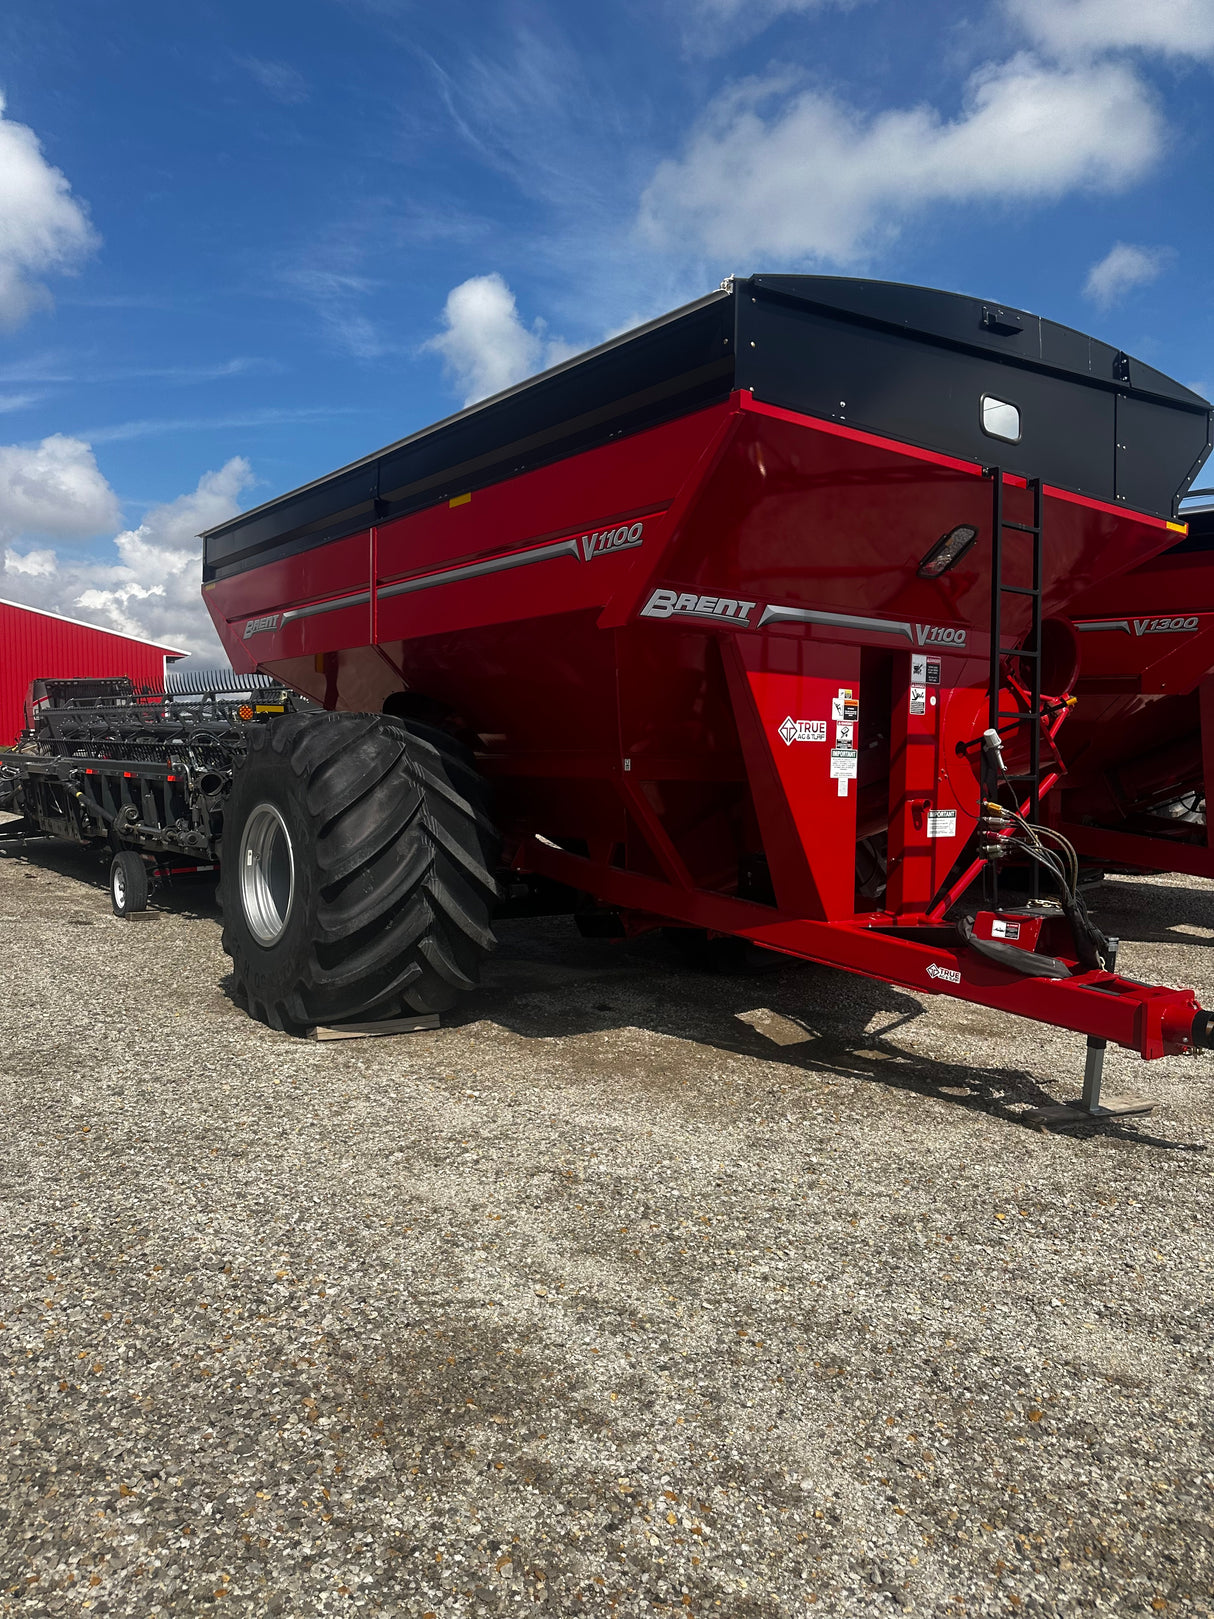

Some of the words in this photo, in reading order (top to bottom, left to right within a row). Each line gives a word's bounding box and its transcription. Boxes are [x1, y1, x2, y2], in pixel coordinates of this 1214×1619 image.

[582, 523, 643, 561] V1100
[640, 589, 757, 619] BRENT
[243, 615, 279, 640] BRENT
[916, 624, 966, 646] V1100
[1133, 617, 1199, 636] V1300
[798, 722, 825, 733] TRUE
[940, 969, 960, 979] TRUE
